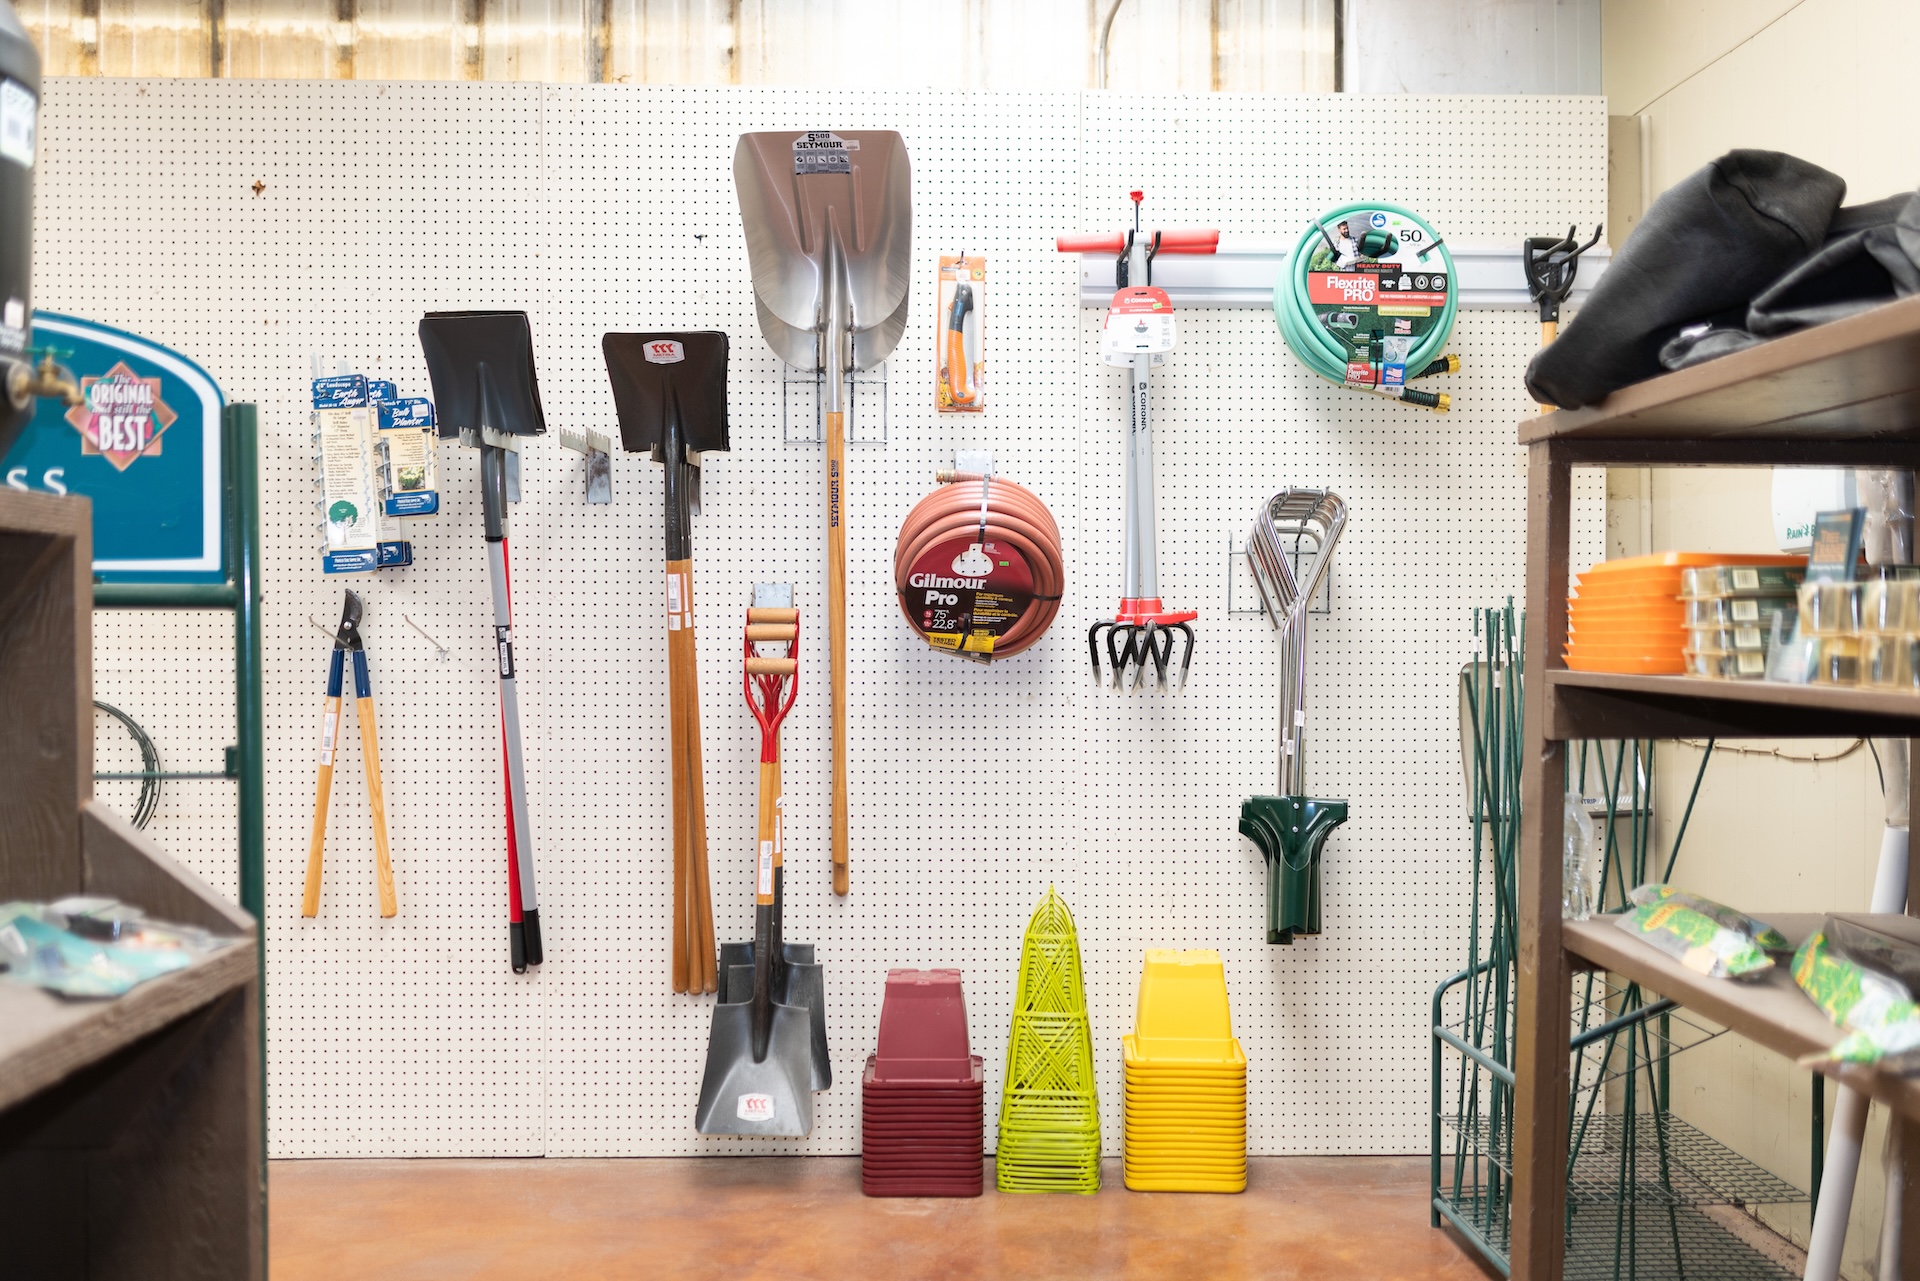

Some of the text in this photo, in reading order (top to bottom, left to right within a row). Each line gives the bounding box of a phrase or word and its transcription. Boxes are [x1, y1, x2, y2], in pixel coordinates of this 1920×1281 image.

[1400, 229, 1422, 242] 50
[1327, 275, 1376, 290] Flexrite
[1344, 288, 1374, 302] PRO
[113, 373, 131, 385] The
[91, 384, 153, 404] ORIGINAL
[332, 389, 359, 400] Earth
[391, 417, 424, 428] Planter
[99, 415, 147, 451] BEST
[831, 480, 839, 528] SEYMOUR
[1786, 527, 1803, 540] RAIN
[909, 573, 987, 590] Gilmour
[925, 590, 958, 606] Pro
